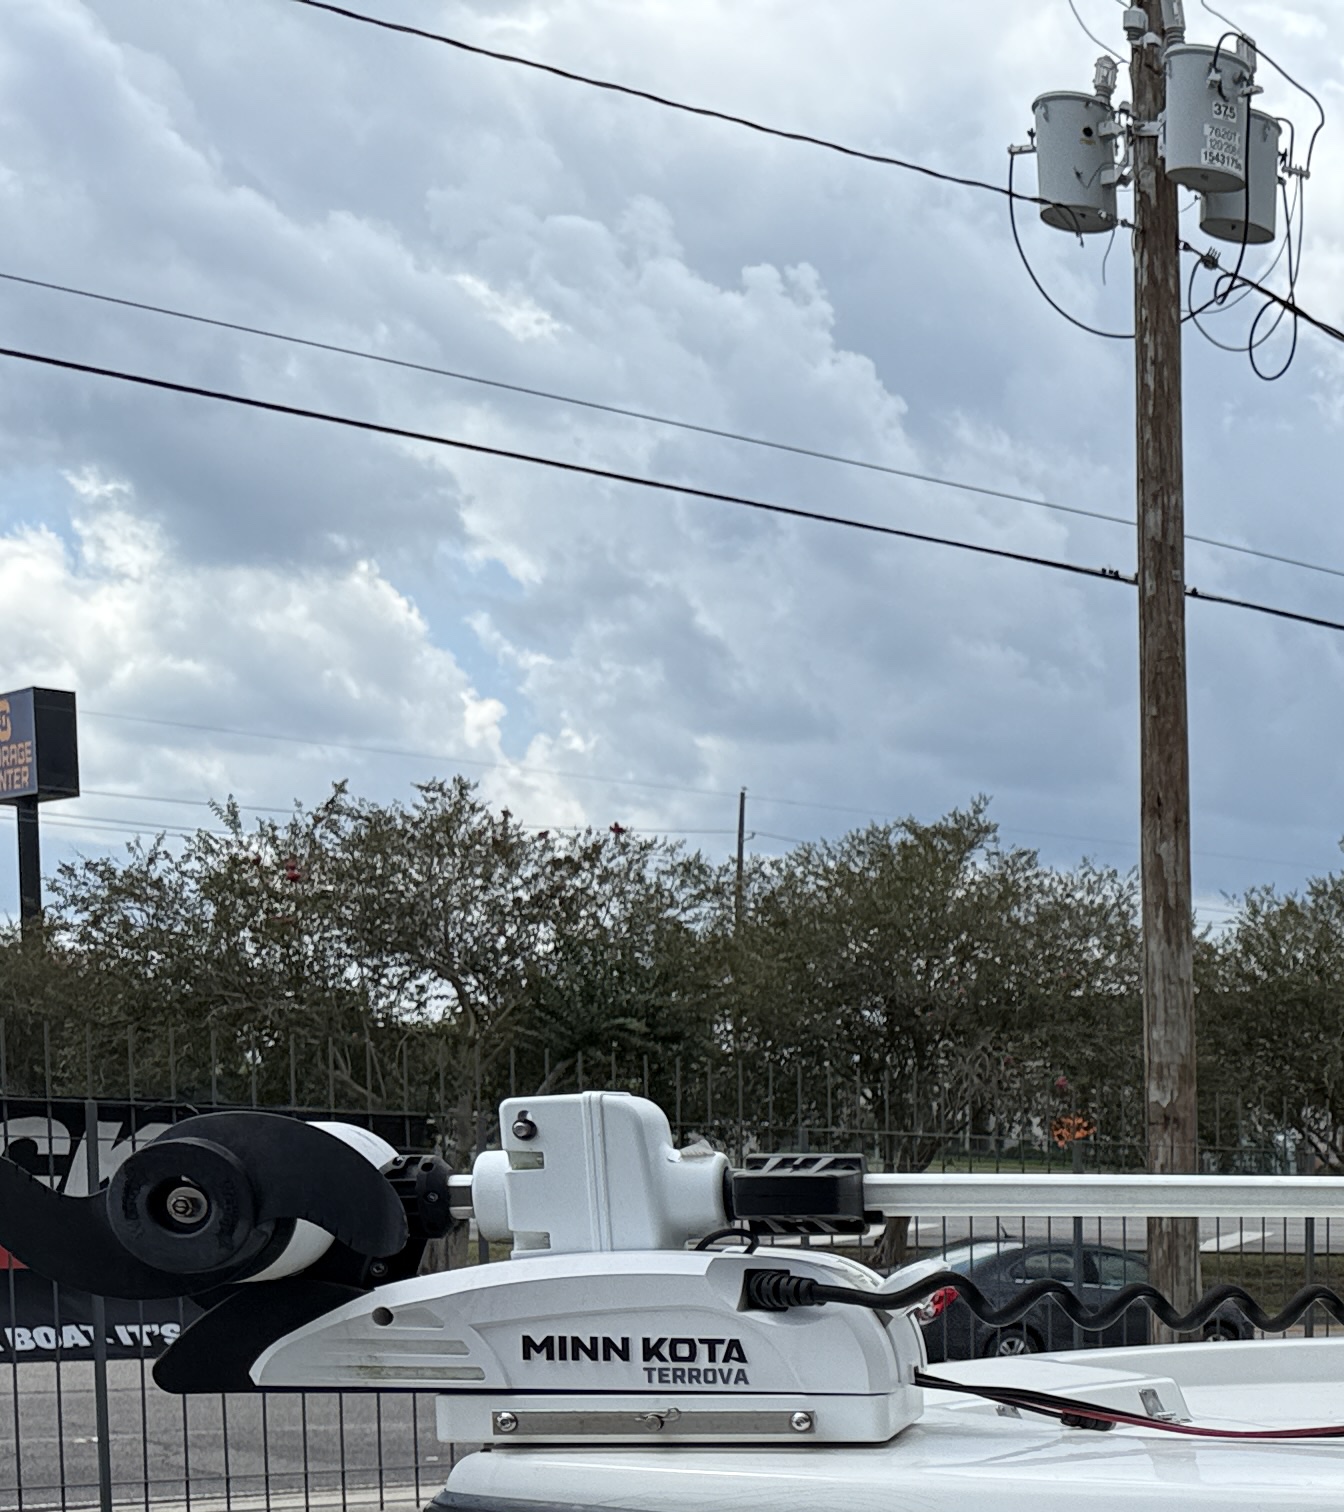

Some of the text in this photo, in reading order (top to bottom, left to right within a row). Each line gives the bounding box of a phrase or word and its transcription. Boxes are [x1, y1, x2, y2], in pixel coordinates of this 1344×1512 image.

[0, 740, 32, 767] RAGE
[521, 1334, 749, 1365] MINN KOTA
[642, 1366, 750, 1386] TERROVA
